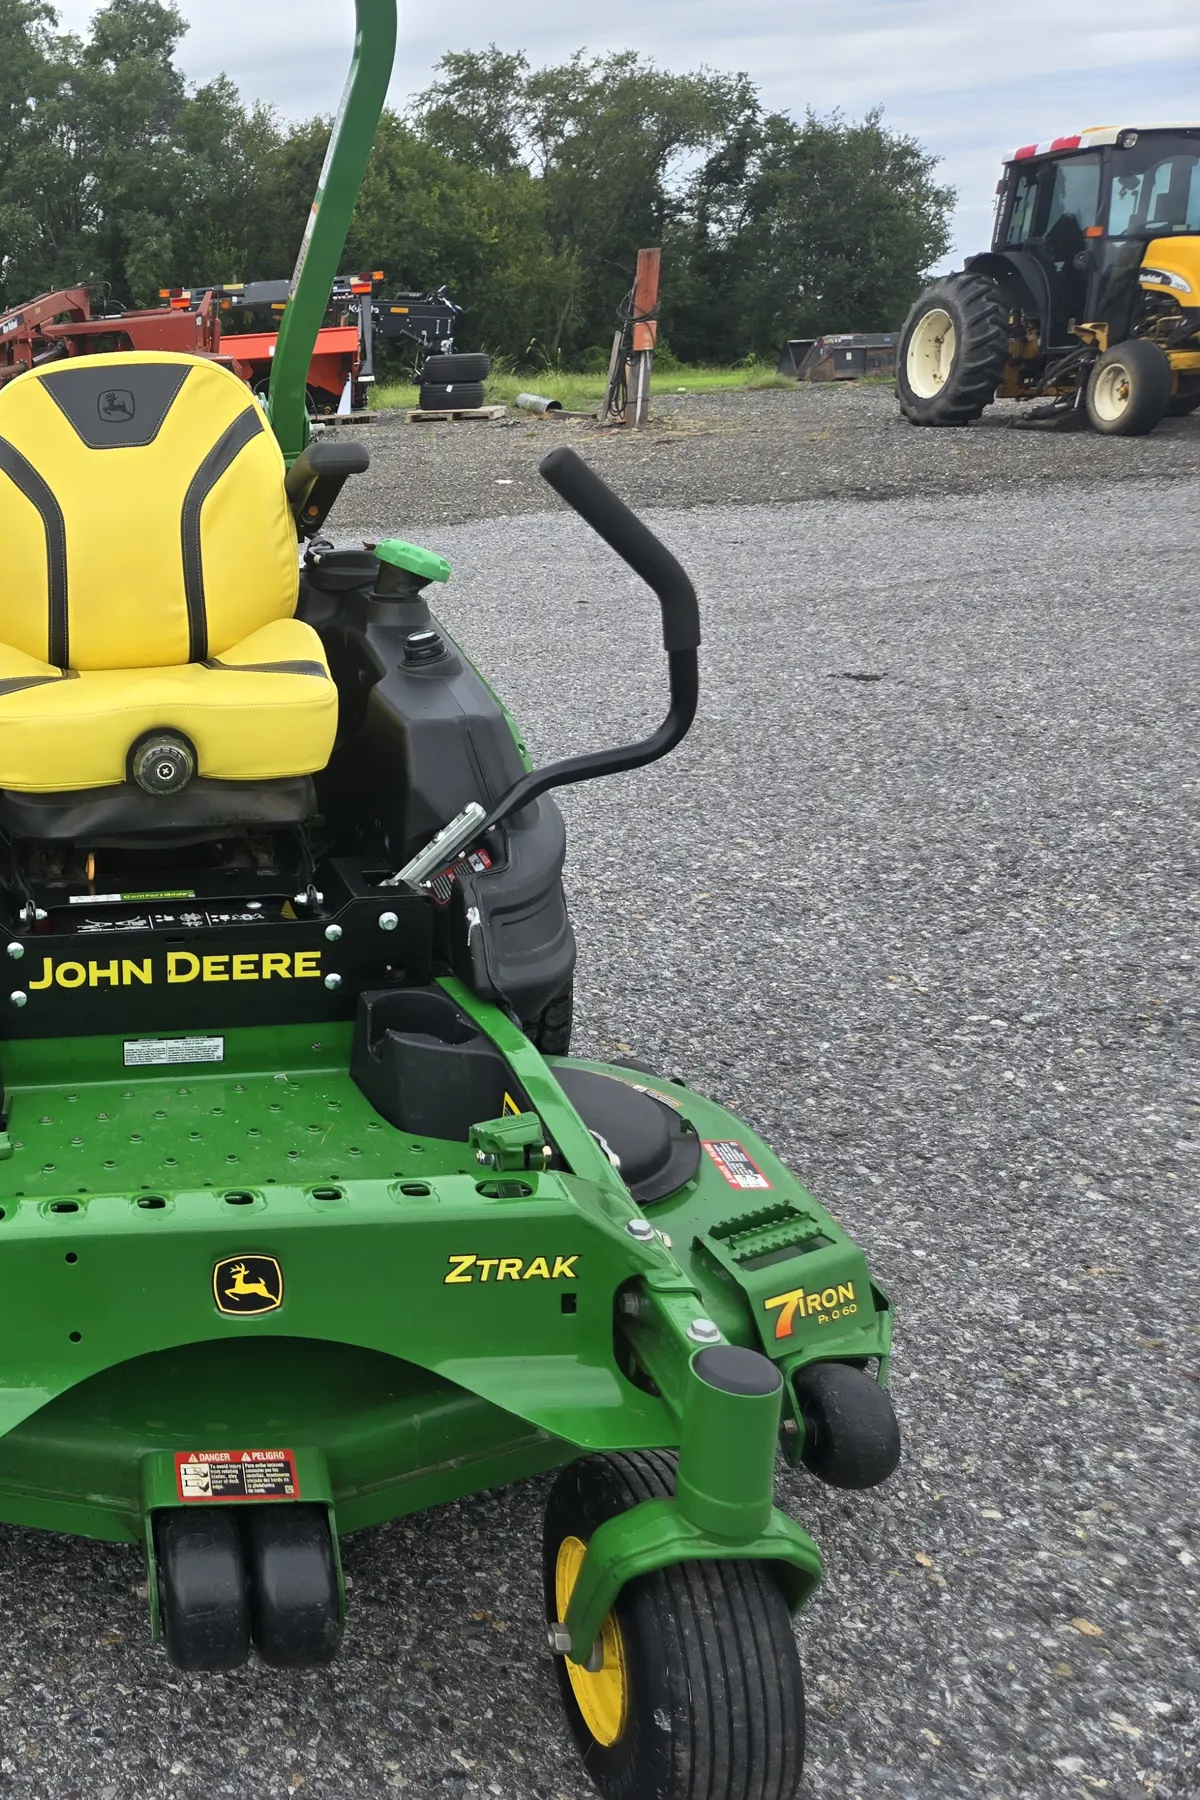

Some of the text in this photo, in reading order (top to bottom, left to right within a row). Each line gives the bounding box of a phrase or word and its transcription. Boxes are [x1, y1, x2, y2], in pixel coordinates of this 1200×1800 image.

[349, 304, 379, 313] Kuta
[29, 951, 322, 990] JOHN DEERE
[444, 1254, 581, 1284] ZTRAK
[842, 1303, 858, 1317] 60
[199, 1453, 231, 1462] DANGER
[251, 1451, 285, 1461] PELIGRO
